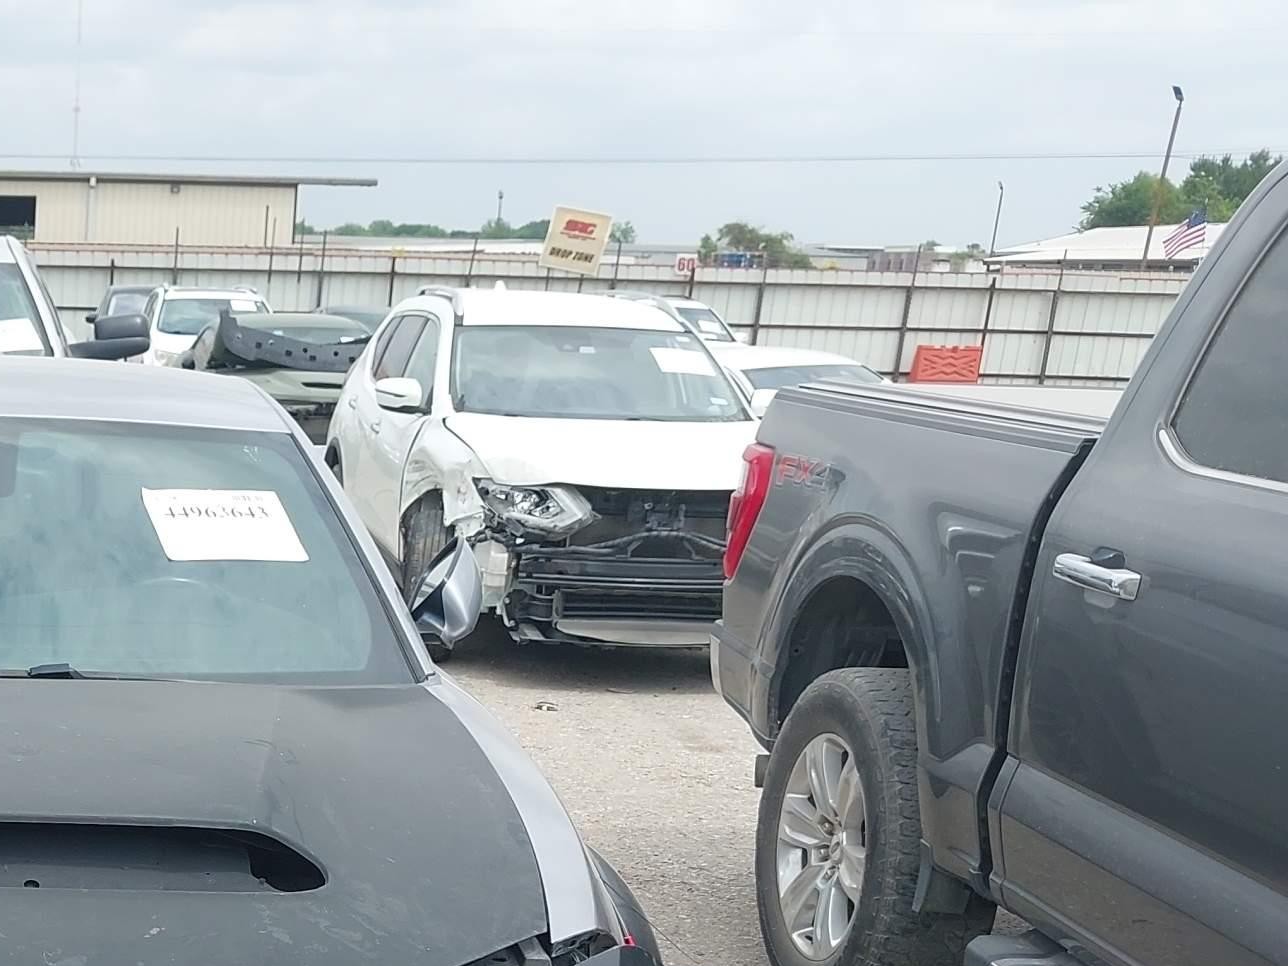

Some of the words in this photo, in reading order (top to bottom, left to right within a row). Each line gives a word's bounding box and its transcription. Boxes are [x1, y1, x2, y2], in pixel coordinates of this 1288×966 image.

[549, 246, 573, 259] DROP
[572, 251, 595, 264] ZONE
[677, 257, 696, 272] 60
[775, 454, 830, 491] FX4
[164, 505, 270, 519] 44963643
